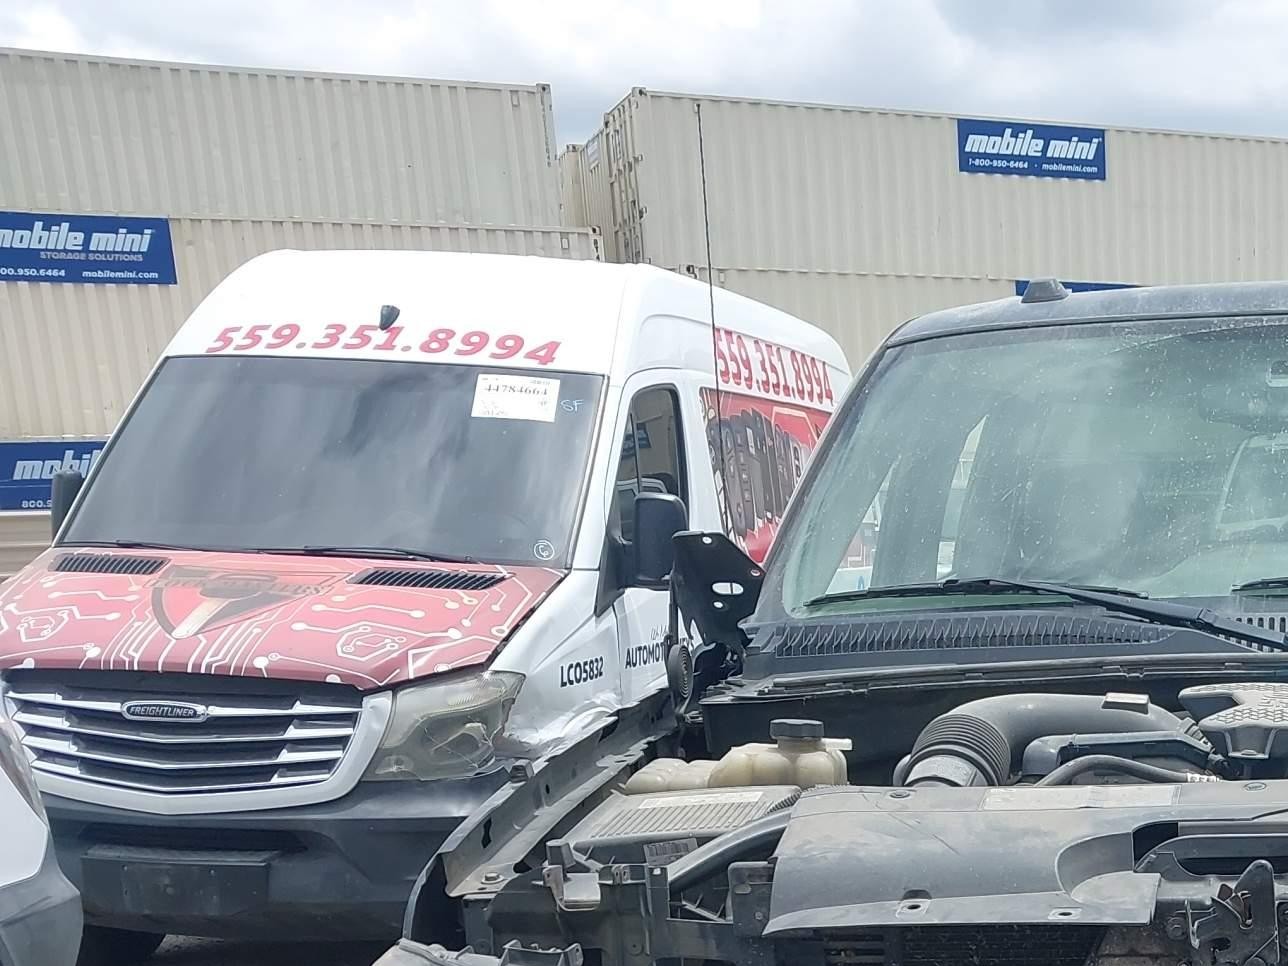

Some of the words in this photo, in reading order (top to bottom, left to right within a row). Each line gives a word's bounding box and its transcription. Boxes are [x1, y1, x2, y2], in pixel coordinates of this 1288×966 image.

[965, 128, 1044, 157] mobile
[1046, 137, 1099, 160] mini
[968, 158, 1028, 169] 1-800-950-6464
[1042, 163, 1098, 173] mobilemini.com
[89, 228, 151, 252] mini
[40, 251, 87, 261] STORAGE
[88, 253, 143, 262] SOLUTIONS
[0, 267, 66, 277] 00.950.6464
[82, 270, 159, 279] mobilemini.com
[205, 323, 562, 366] 559.351.8994
[715, 327, 834, 405] 559.351.8994
[625, 642, 665, 669] AUTOMOT
[129, 705, 195, 717] FREIGHTLINER
